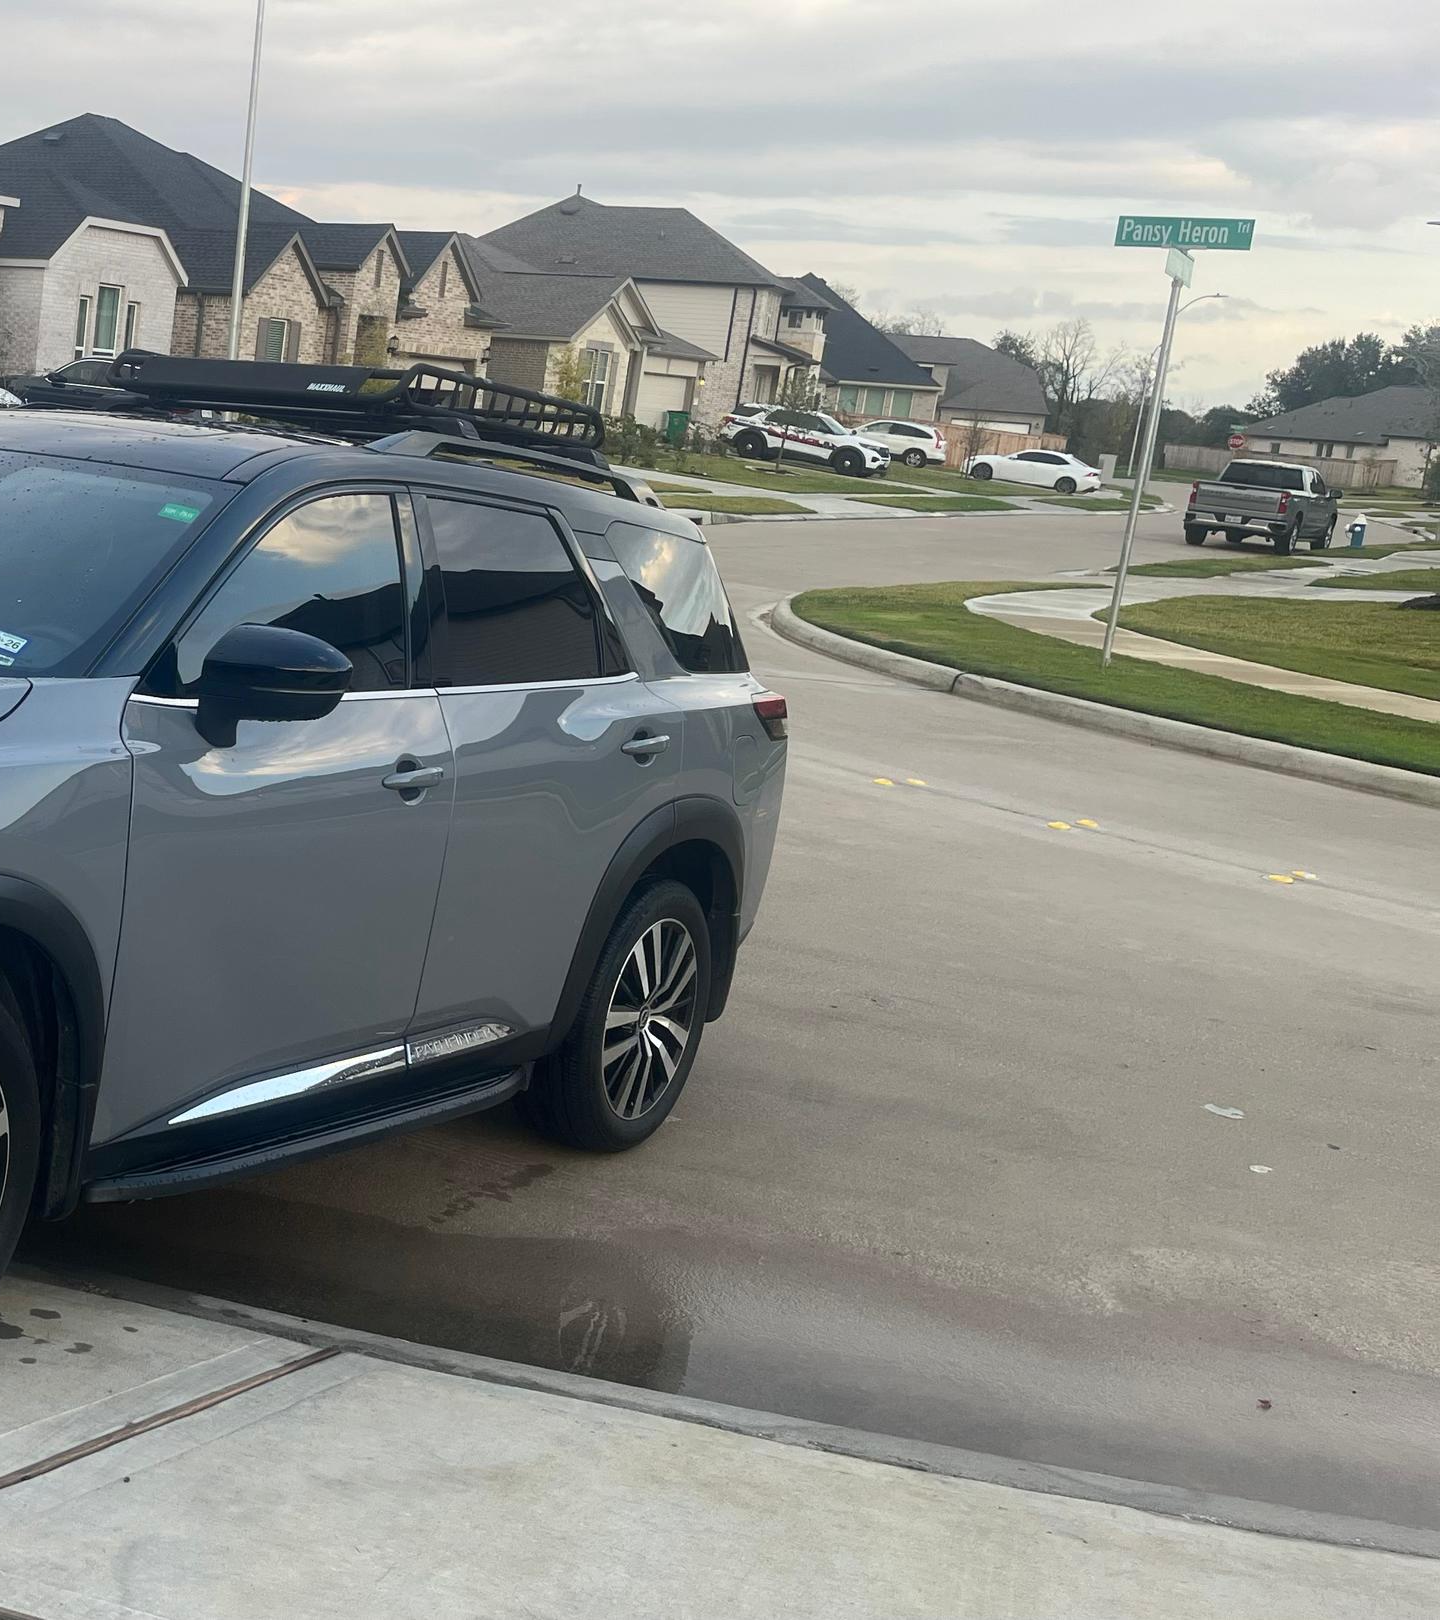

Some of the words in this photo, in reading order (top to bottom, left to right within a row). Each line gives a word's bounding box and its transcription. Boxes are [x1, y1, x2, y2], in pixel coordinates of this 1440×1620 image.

[1121, 218, 1173, 245] Pansy
[1178, 220, 1229, 244] Heron
[1237, 221, 1251, 234] Trl
